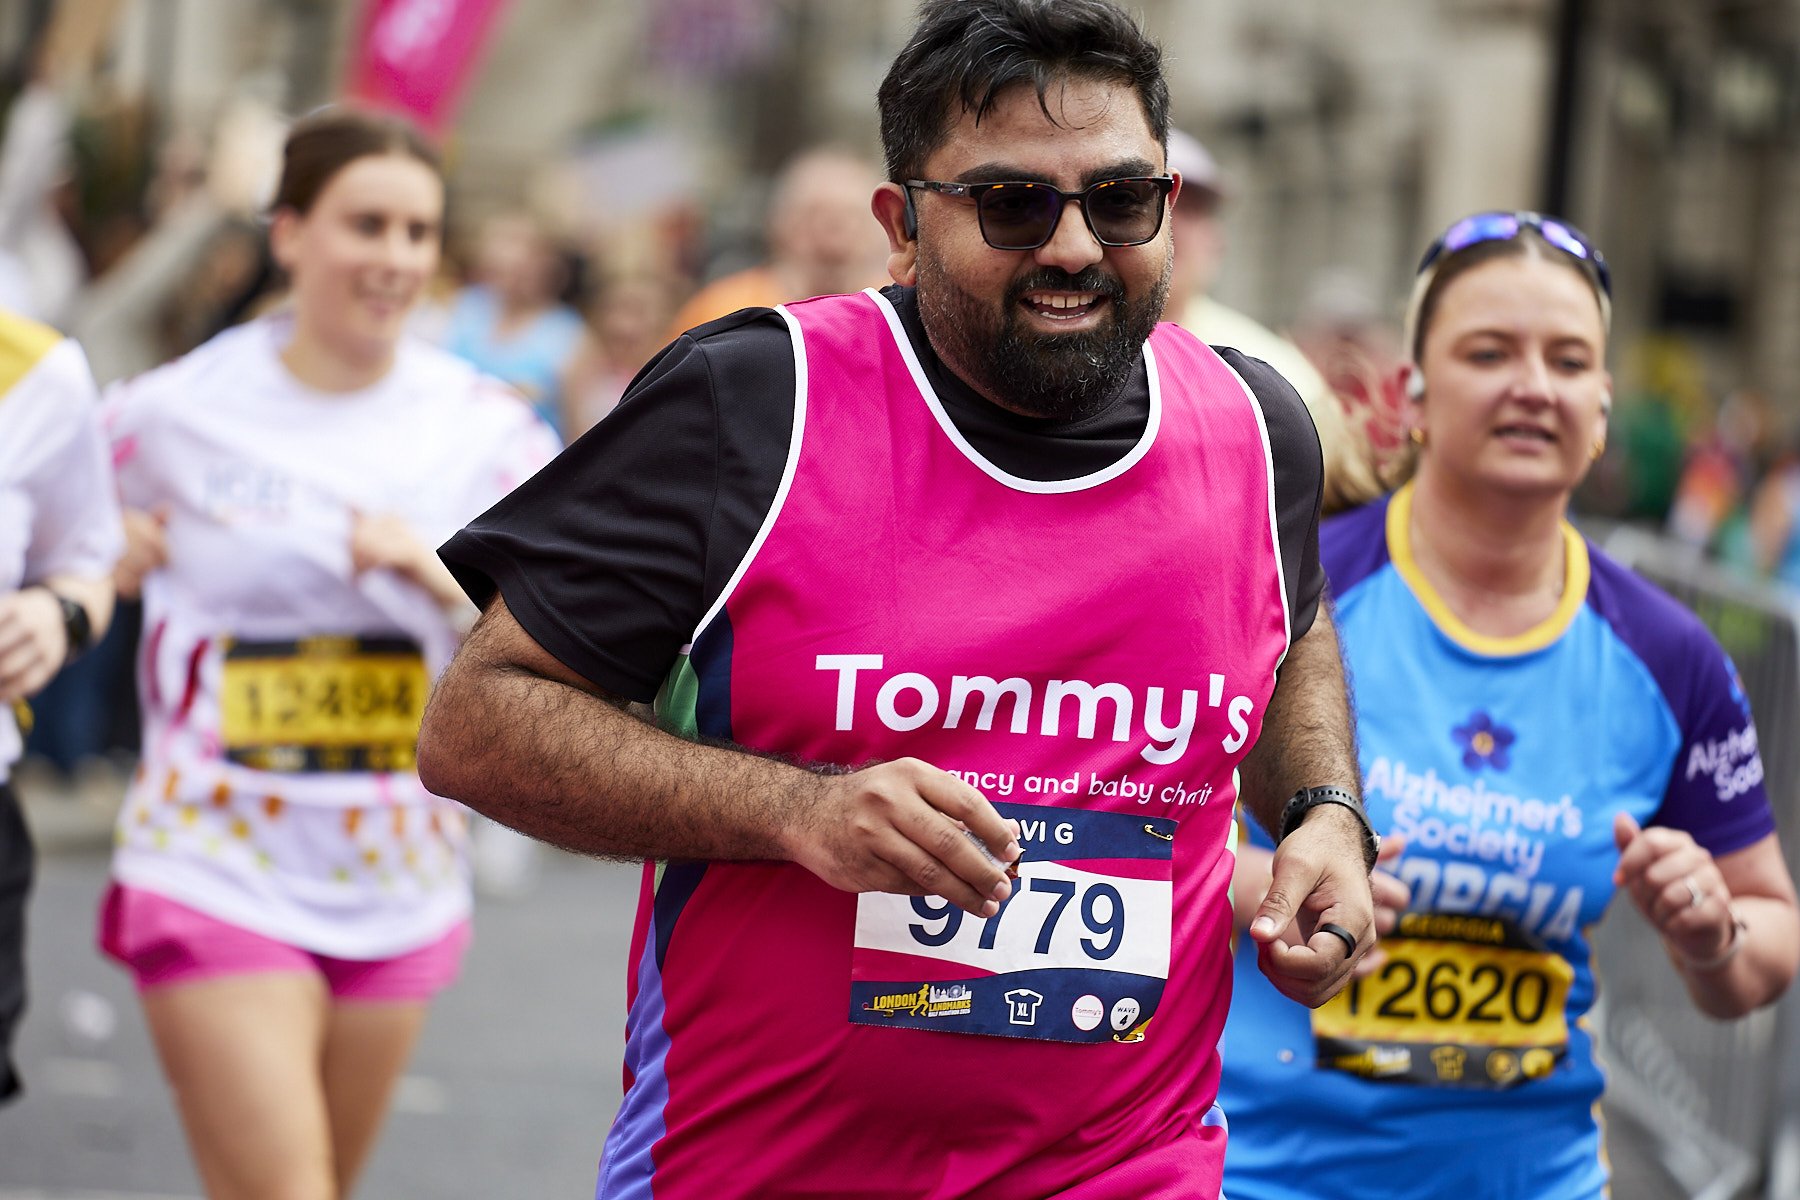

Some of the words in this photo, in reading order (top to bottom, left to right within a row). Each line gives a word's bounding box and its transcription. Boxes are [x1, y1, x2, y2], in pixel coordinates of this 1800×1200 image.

[814, 653, 1255, 765] Tommy's
[1023, 772, 1080, 794] and
[1088, 772, 1154, 805] baby
[1364, 756, 1583, 839] Alzheimer's
[1054, 823, 1074, 845] G
[1391, 799, 1545, 880] Society
[908, 876, 1125, 961] 9779
[873, 993, 917, 1010] LONDON
[1348, 958, 1550, 1026] 12620
[928, 1000, 972, 1012] LANDMARKS
[1017, 1002, 1029, 1017] XL
[1117, 1006, 1136, 1014] WAVE
[1119, 1014, 1129, 1026] 4
